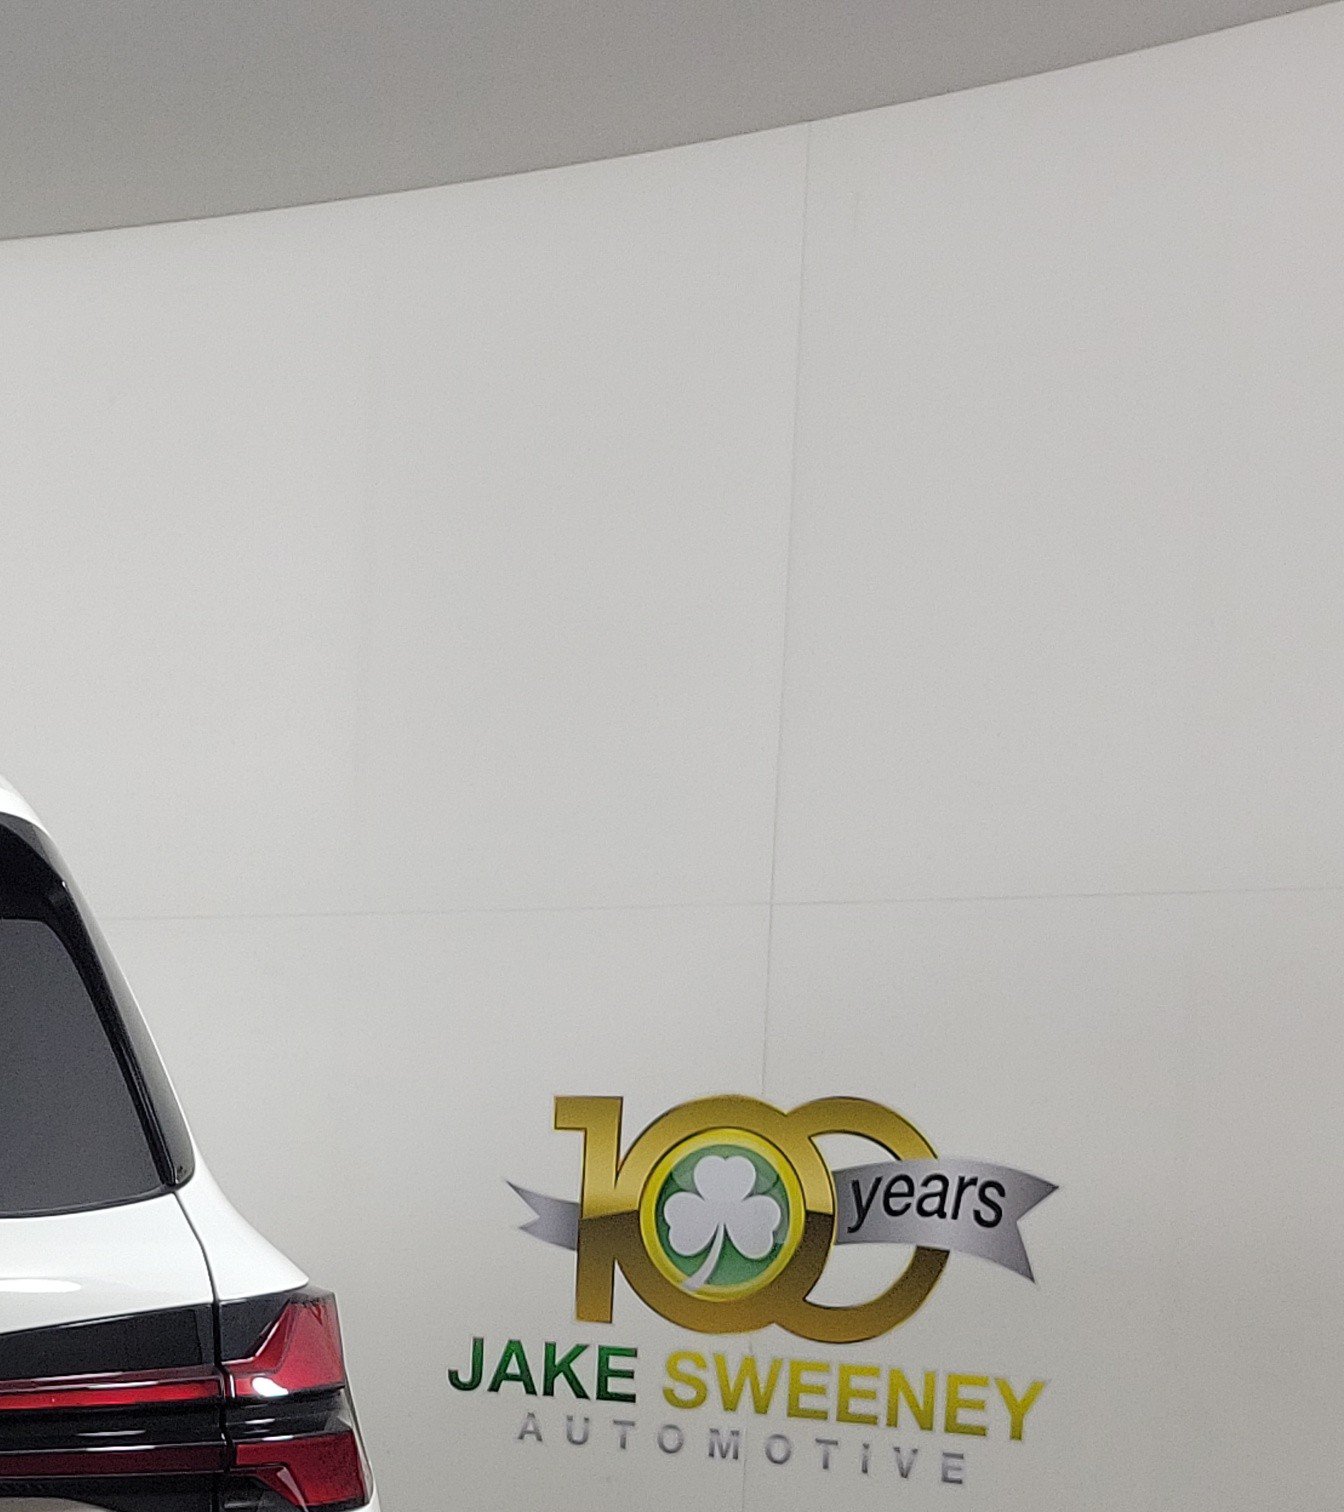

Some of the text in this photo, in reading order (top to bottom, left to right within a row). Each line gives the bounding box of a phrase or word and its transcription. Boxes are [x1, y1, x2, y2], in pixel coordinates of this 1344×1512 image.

[847, 1173, 1006, 1233] years
[447, 1336, 1047, 1442] JAKE SWEENEY
[517, 1411, 966, 1485] AUTOMOTIVE
